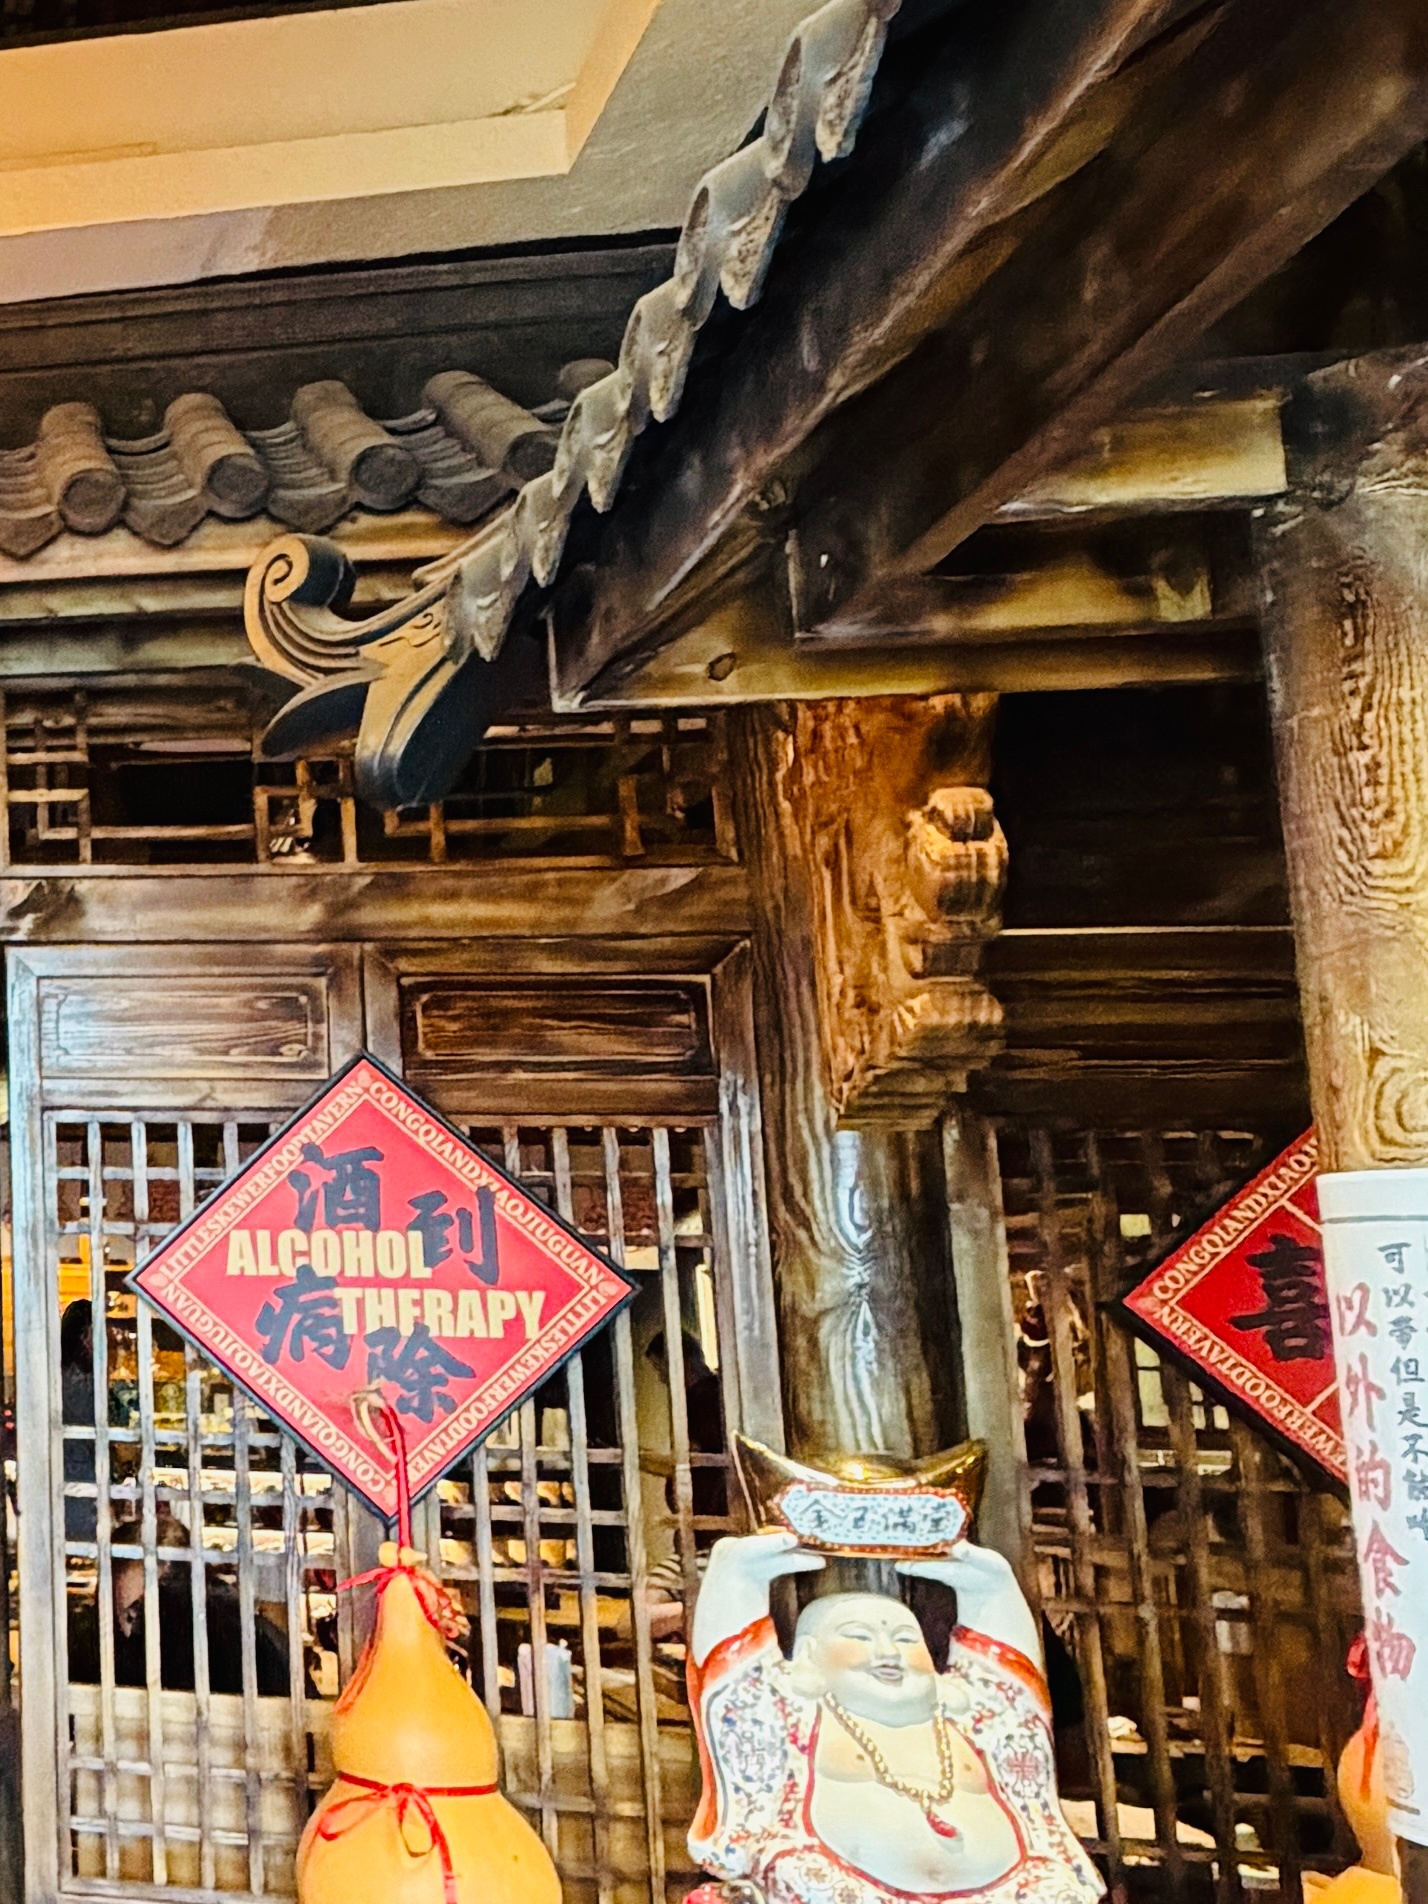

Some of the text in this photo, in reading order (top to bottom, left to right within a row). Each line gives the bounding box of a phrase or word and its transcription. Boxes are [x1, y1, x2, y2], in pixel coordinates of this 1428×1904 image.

[226, 1229, 433, 1279] ALCOHOL
[334, 1286, 546, 1341] THERAPY
[402, 1291, 608, 1482] LITTLESKEWERFOODTAVE
[1336, 1282, 1417, 1681] 以外的食物
